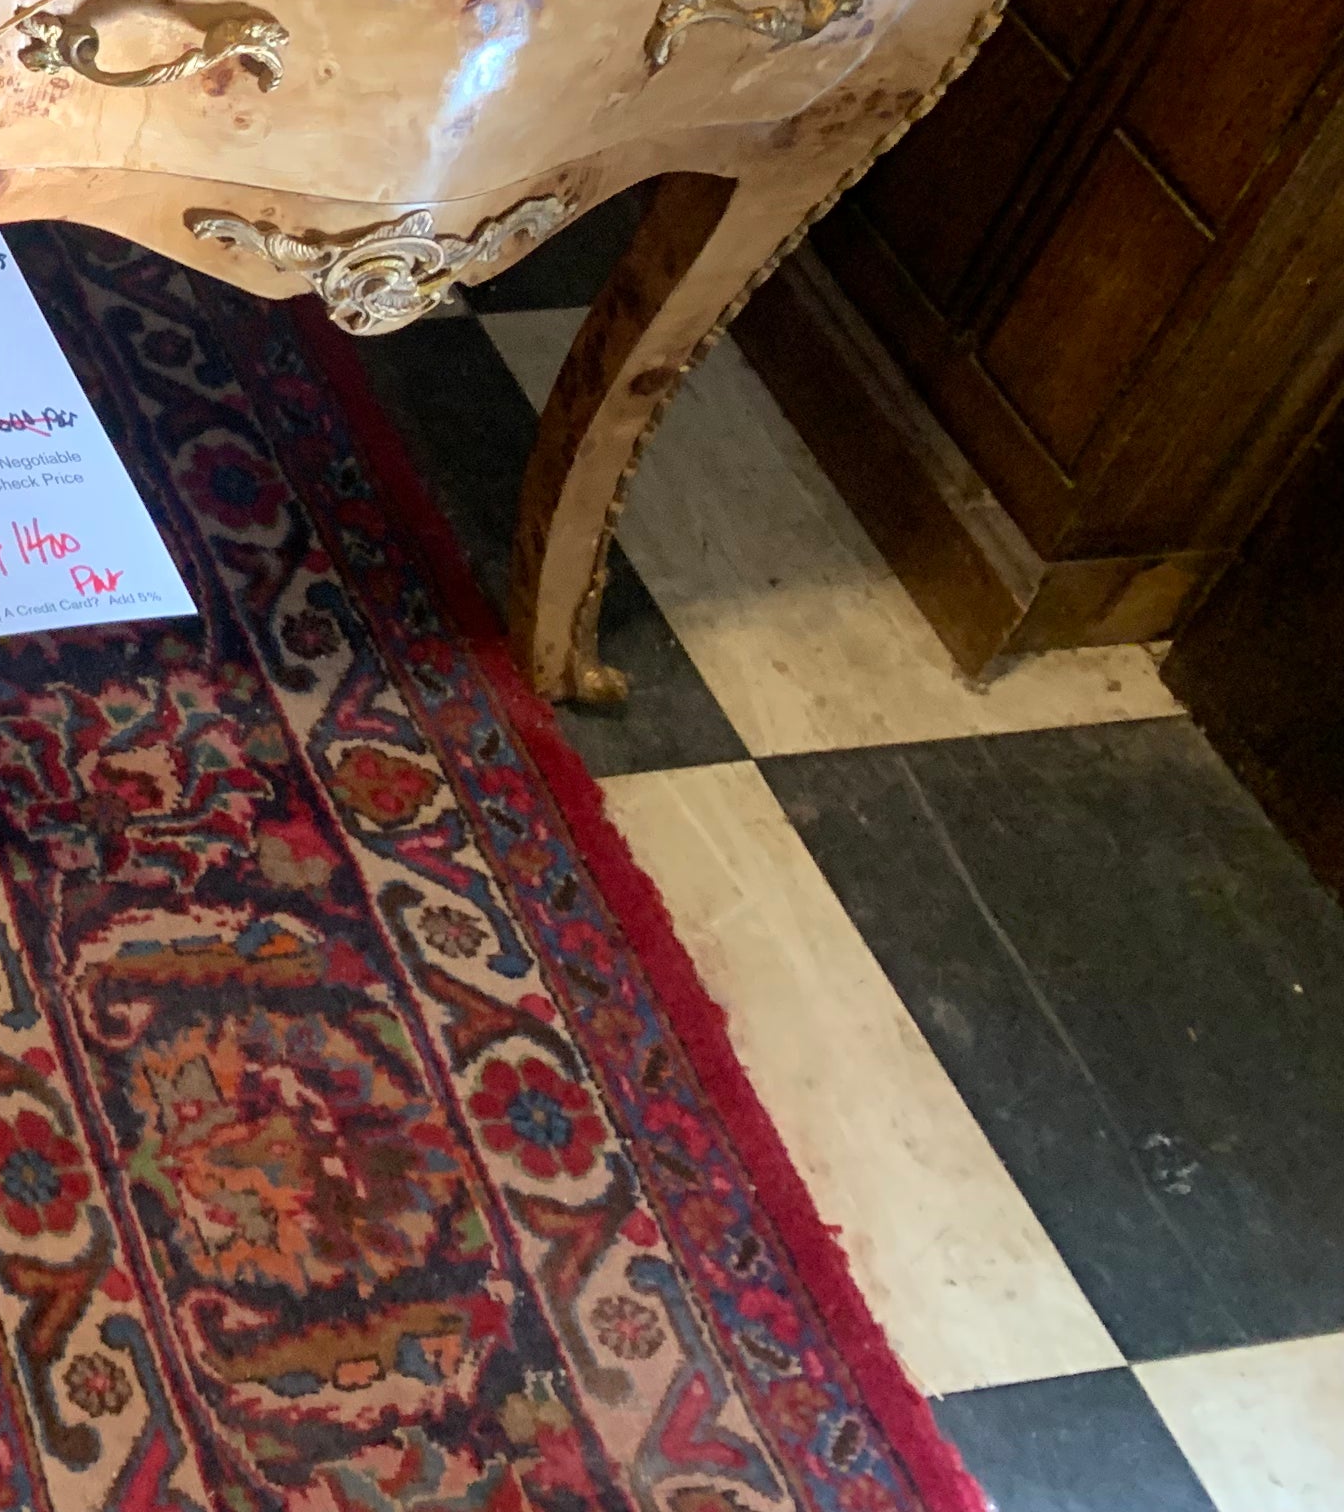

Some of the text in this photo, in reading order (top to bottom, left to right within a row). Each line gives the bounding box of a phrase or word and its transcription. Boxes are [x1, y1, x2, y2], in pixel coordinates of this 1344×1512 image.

[42, 470, 85, 487] Price
[4, 607, 15, 619] A
[17, 602, 58, 618] Credit
[59, 596, 100, 613] Card?
[109, 591, 136, 605] Add
